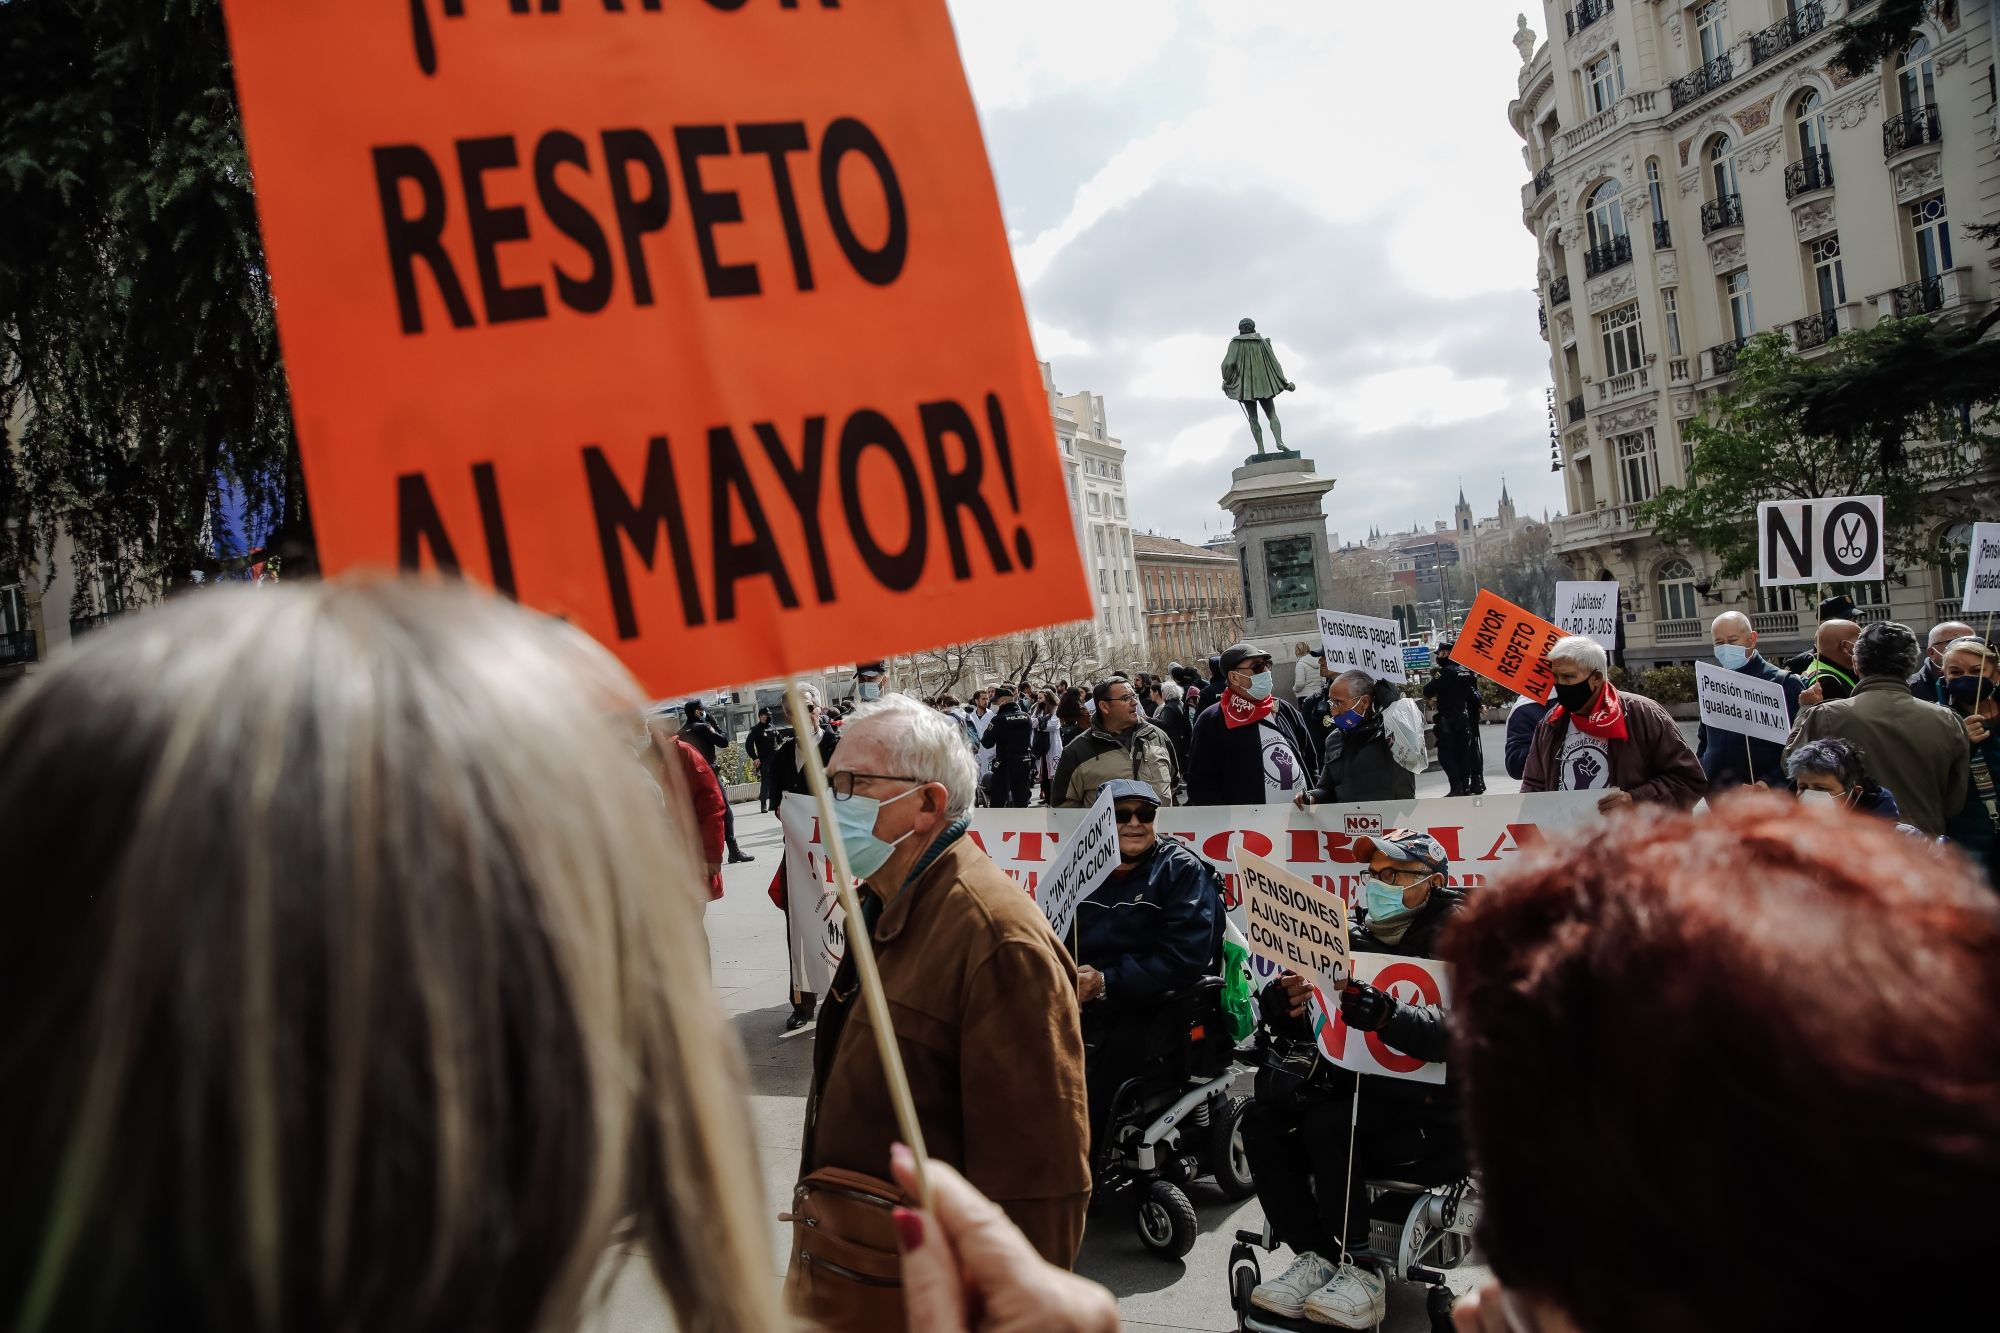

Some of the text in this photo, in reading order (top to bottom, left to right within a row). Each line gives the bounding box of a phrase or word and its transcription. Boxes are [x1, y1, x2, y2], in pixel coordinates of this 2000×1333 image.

[371, 116, 908, 335] RESPETO
[582, 392, 1036, 641] MAYOR!
[1767, 500, 1879, 580] NO
[1321, 616, 1397, 649] Pensiones pagad
[1327, 648, 1345, 664] con
[1362, 648, 1377, 670] IPC
[1472, 608, 1507, 661] ¡MAYOR
[1497, 622, 1536, 678] RESPETO
[1524, 676, 1547, 698] AL
[1701, 675, 1780, 709] ¡Pensión mínima
[1702, 695, 1742, 719] igualada
[1745, 708, 1753, 722] al
[1243, 867, 1340, 929] ¡PENSIONES
[1250, 922, 1284, 954] CON
[1286, 941, 1309, 966] EL
[1252, 896, 1345, 956] AJUSTADAS
